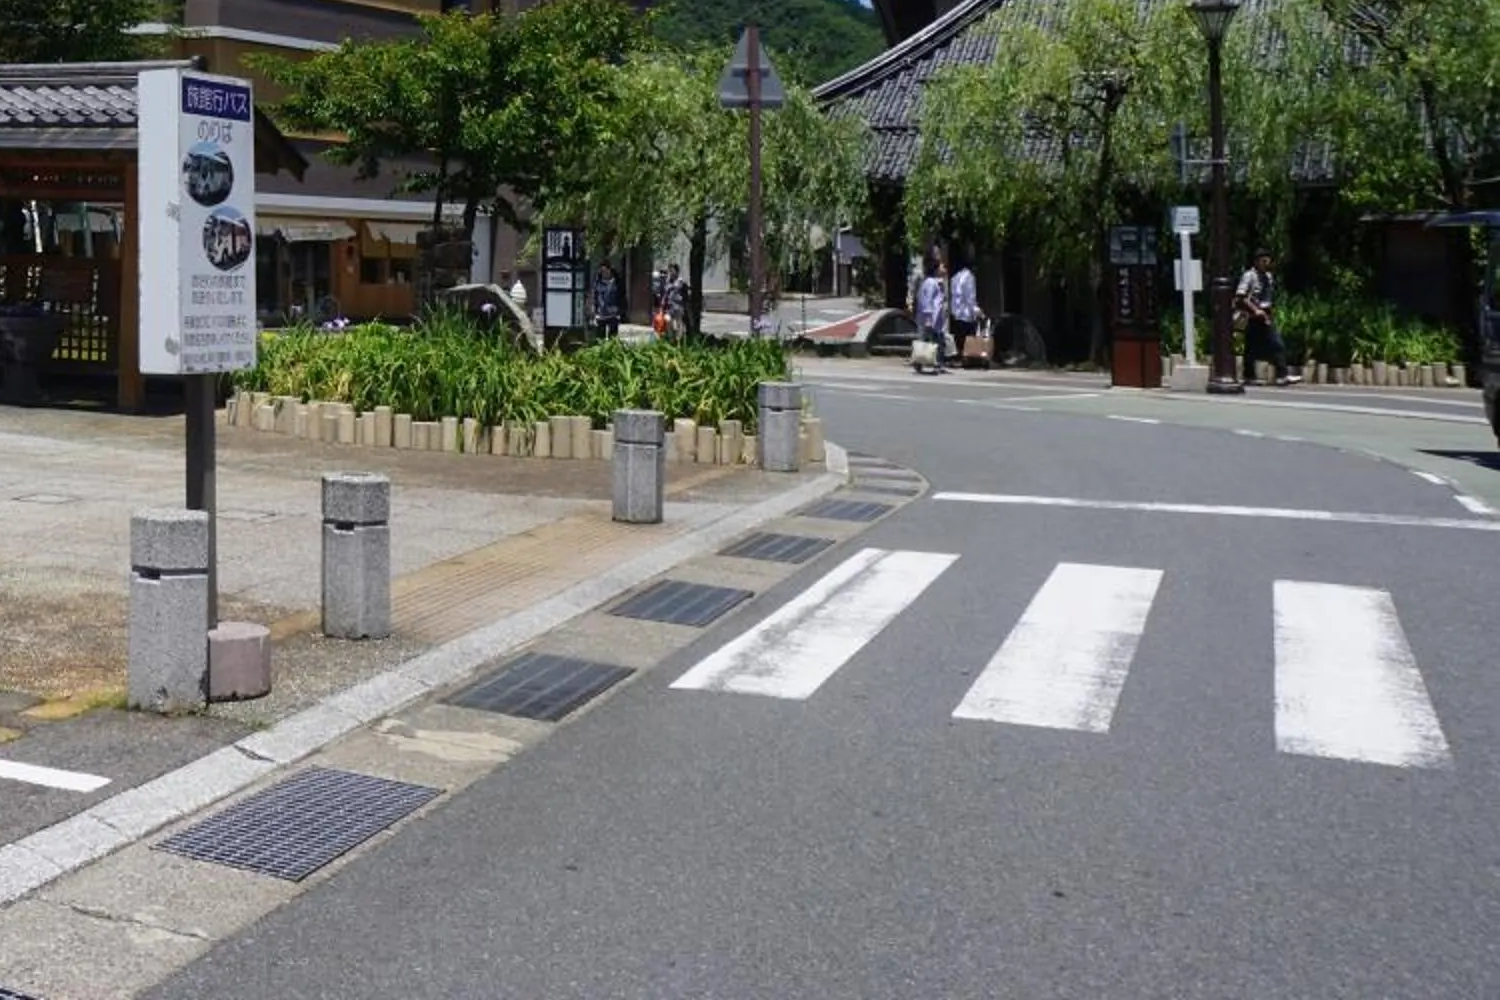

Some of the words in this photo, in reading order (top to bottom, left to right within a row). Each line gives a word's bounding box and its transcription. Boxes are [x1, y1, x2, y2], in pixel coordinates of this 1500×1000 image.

[187, 84, 247, 114] 旅館行バス
[197, 120, 233, 143] のりば
